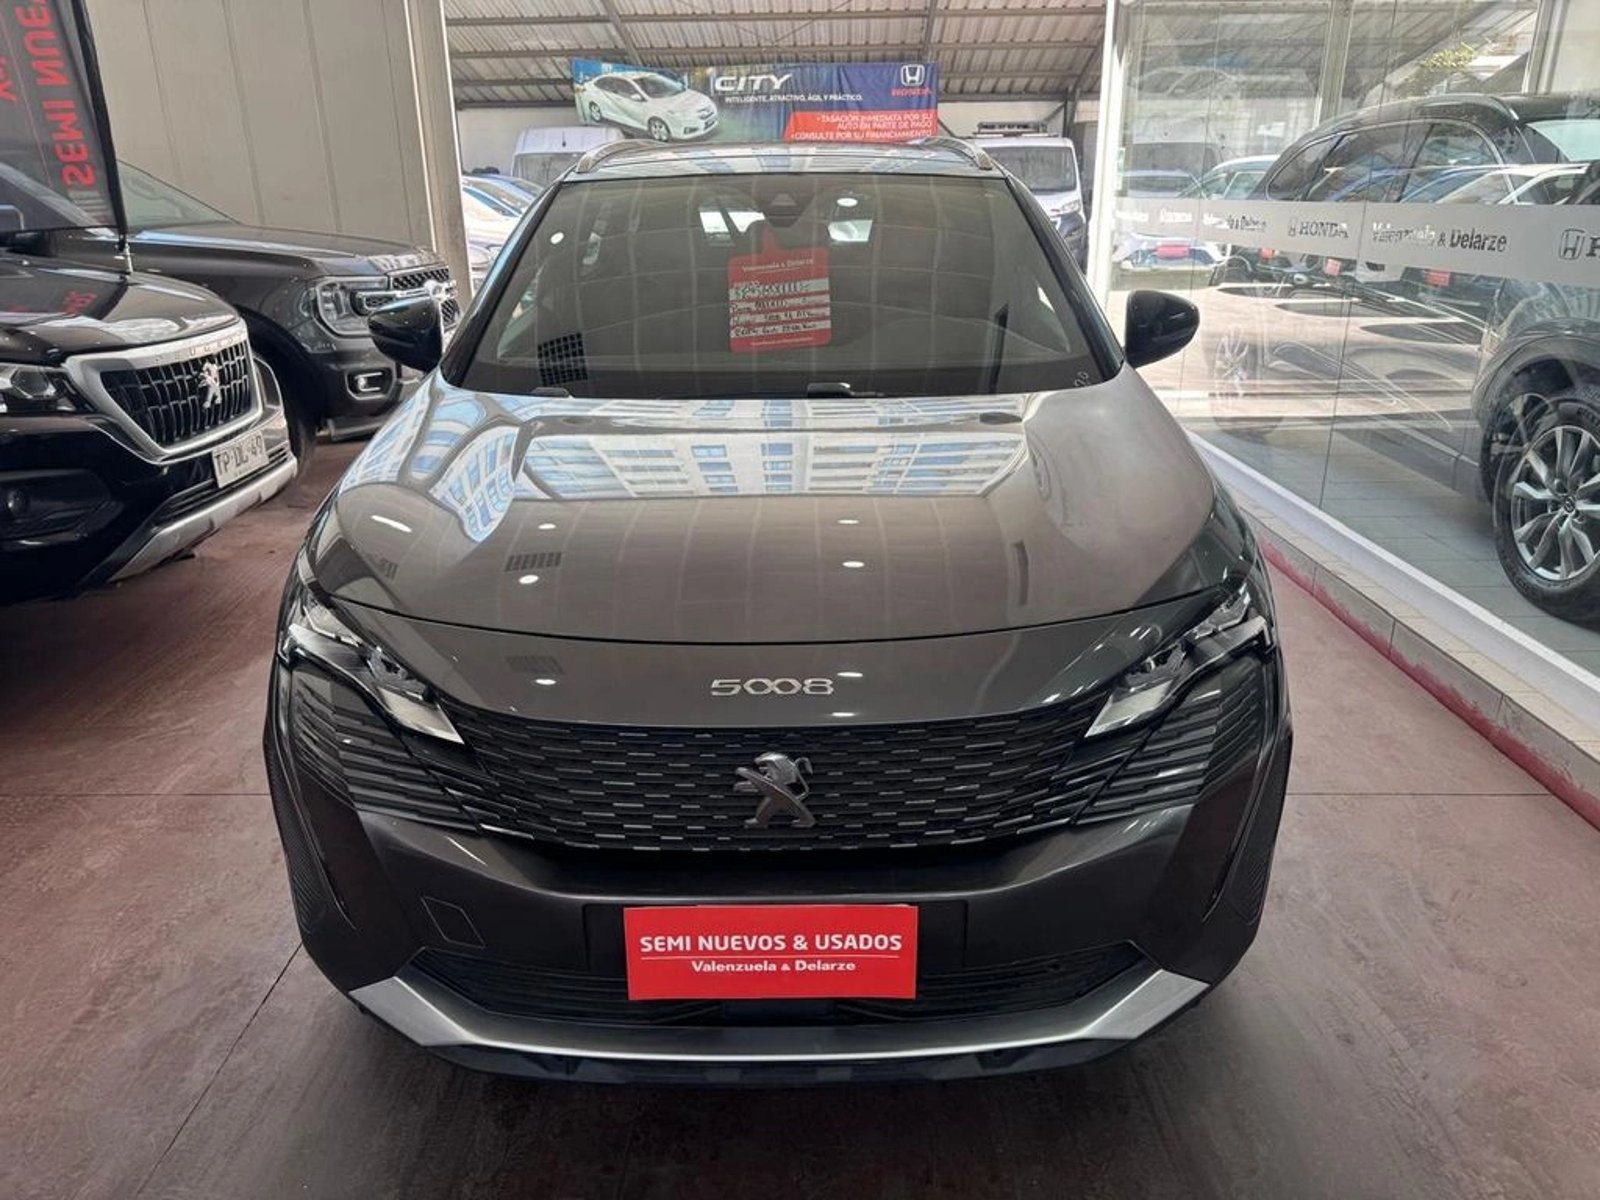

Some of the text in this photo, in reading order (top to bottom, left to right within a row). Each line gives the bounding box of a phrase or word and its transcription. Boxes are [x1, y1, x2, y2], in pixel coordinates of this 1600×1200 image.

[715, 73, 793, 91] CITY
[1299, 222, 1349, 239] HONDA
[1438, 232, 1446, 245] &
[1450, 228, 1508, 253] Delarze
[710, 677, 835, 696] 5008
[639, 933, 903, 952] SEMI NUEVOS & USADOS
[692, 959, 777, 973] Valenzuela
[795, 959, 857, 972] Delarze
